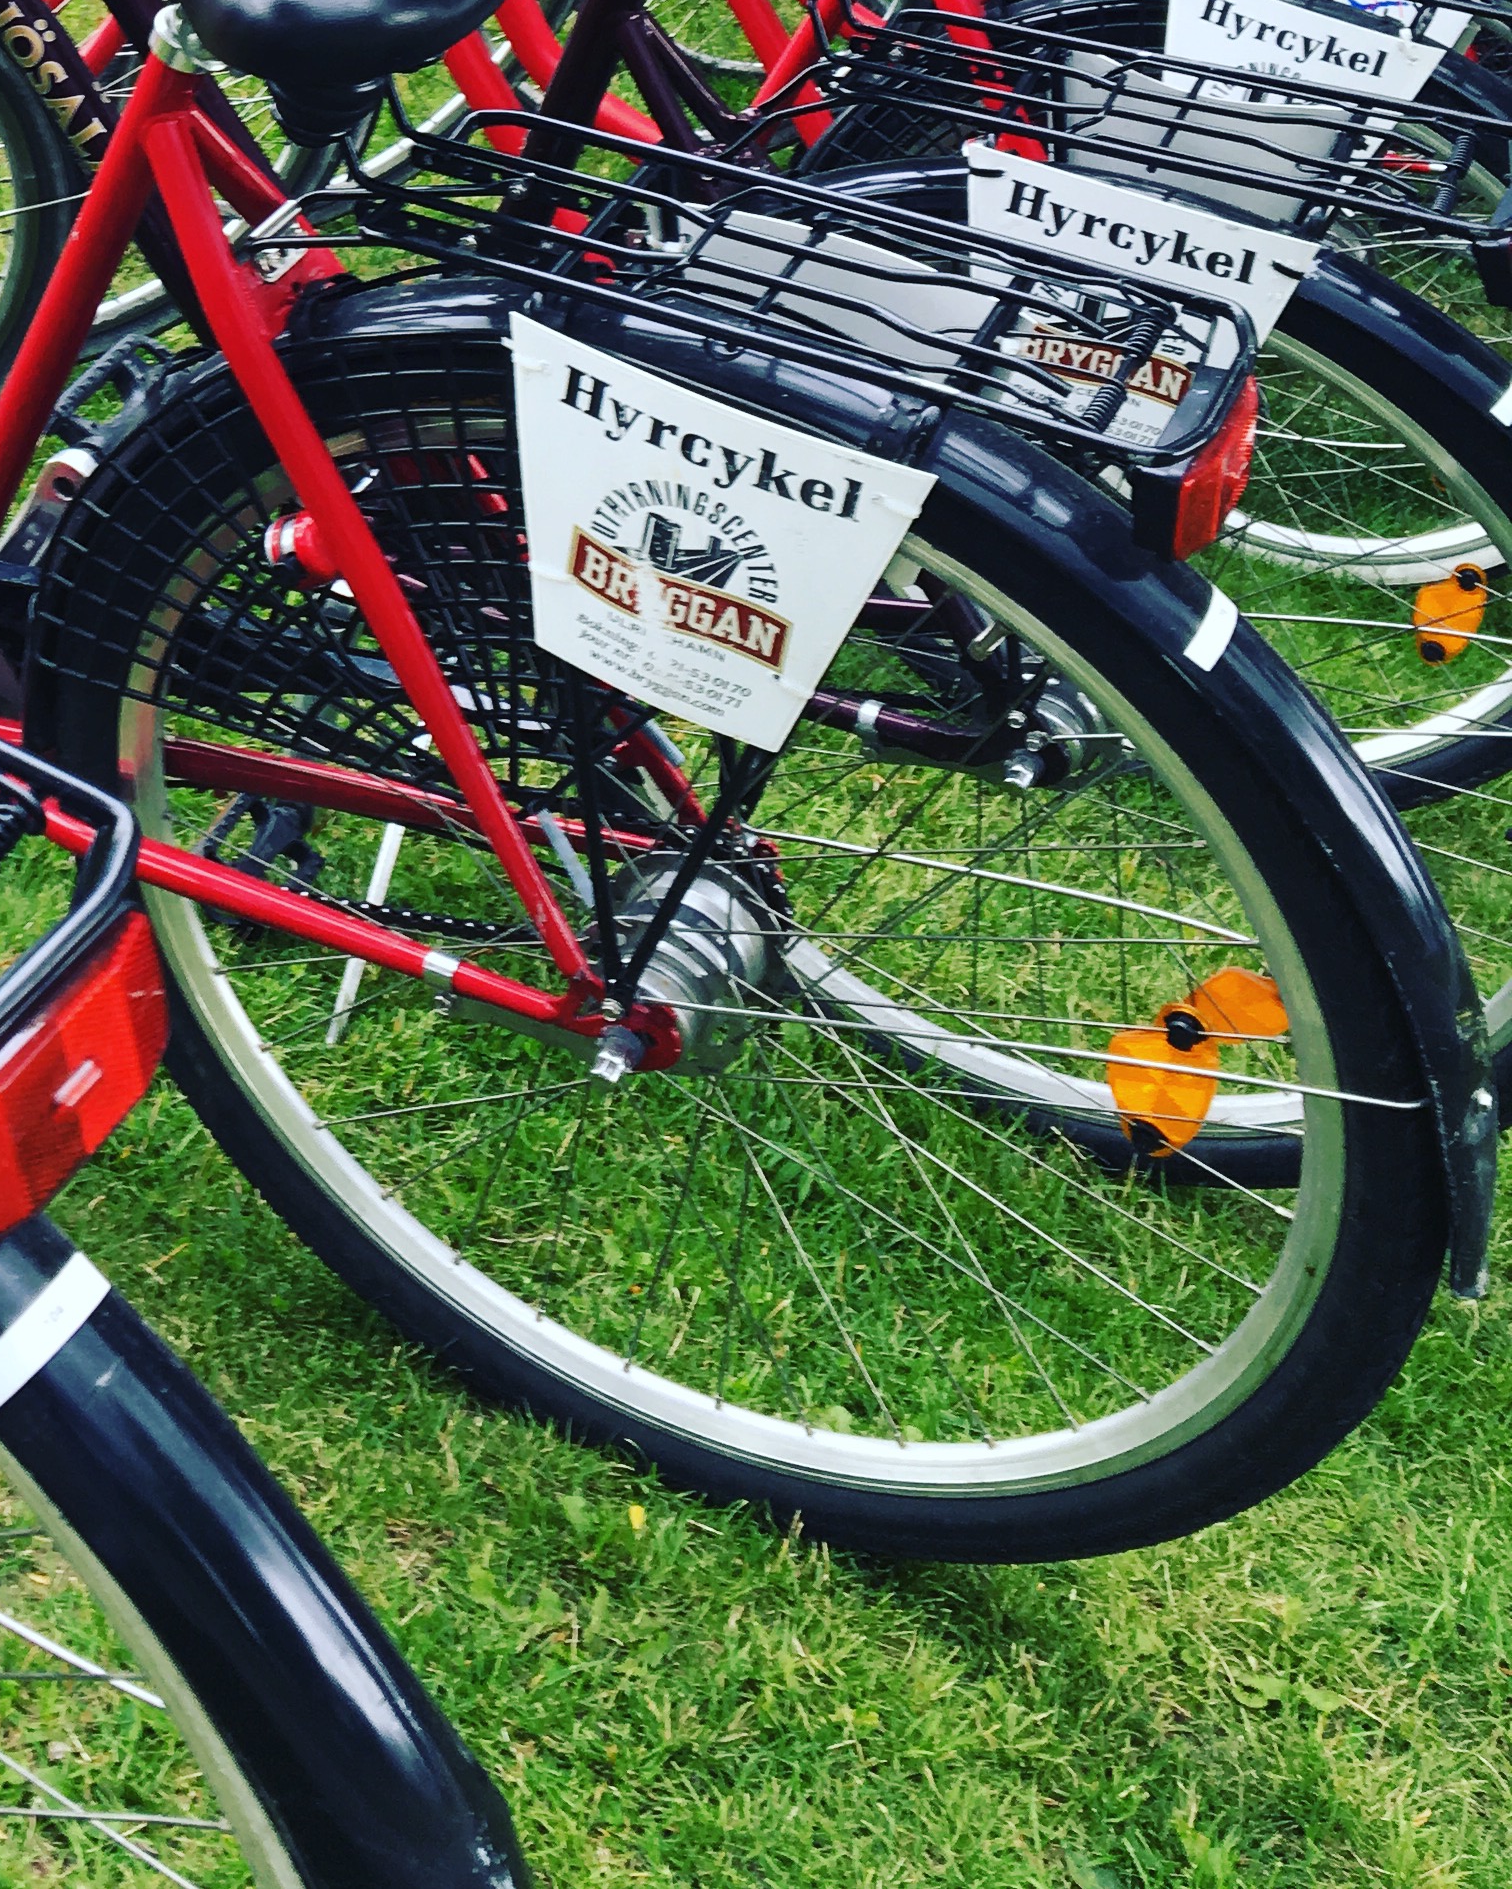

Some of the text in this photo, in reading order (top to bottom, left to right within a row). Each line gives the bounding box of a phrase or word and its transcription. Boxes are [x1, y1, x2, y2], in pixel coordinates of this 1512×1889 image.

[1004, 179, 1258, 285] Hyrcykel
[559, 365, 865, 523] Hyrcykel
[580, 545, 780, 658] BRGGAN
